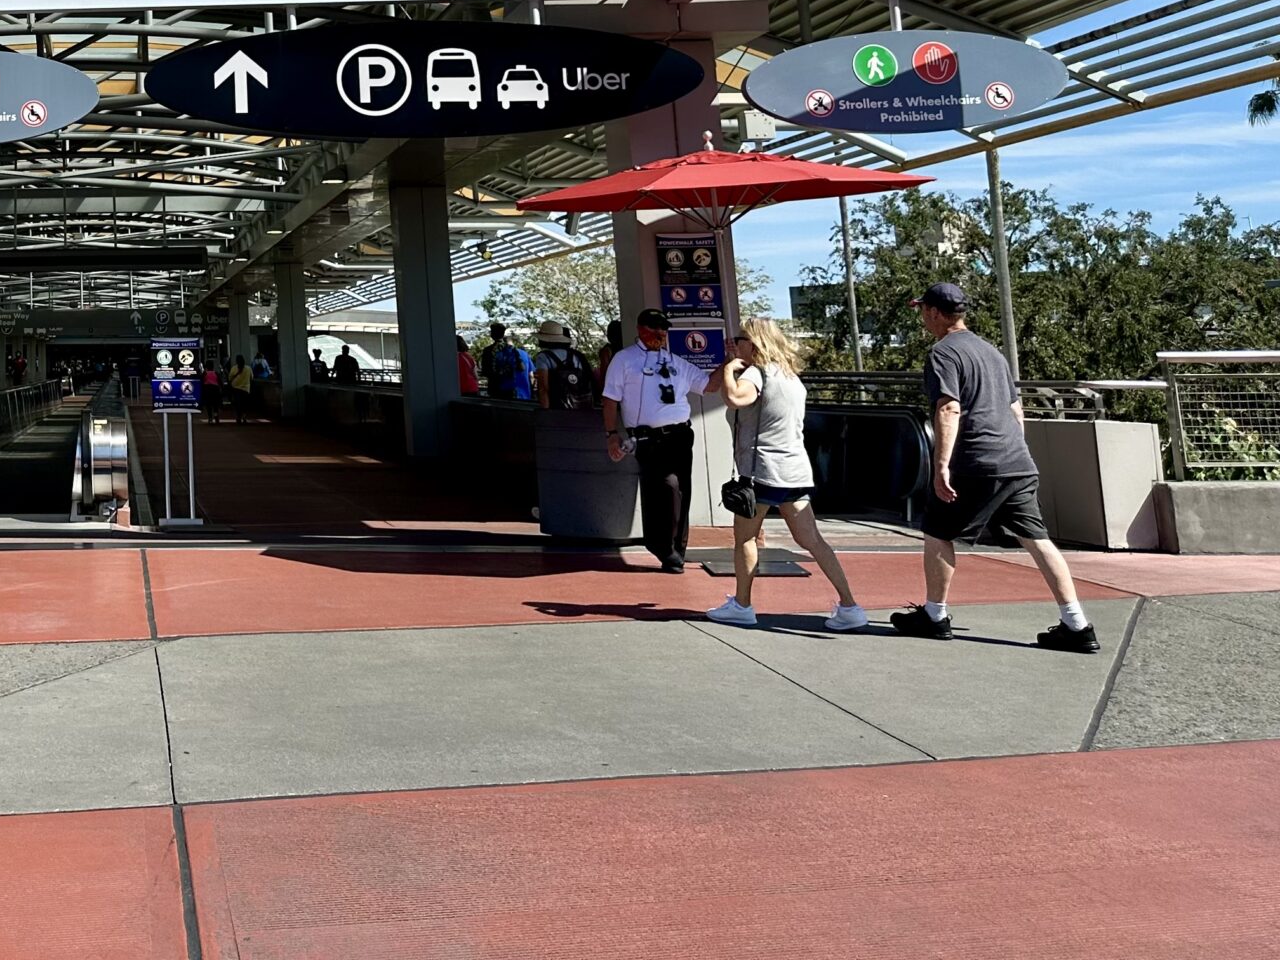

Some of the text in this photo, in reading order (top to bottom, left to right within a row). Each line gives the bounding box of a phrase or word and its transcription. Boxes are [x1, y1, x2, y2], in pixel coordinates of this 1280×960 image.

[358, 56, 631, 104] P Uber
[839, 94, 982, 110] Strollers & Wheelchairs
[880, 110, 944, 123] Prohibited
[13, 313, 30, 322] Way
[207, 314, 228, 324] Uber
